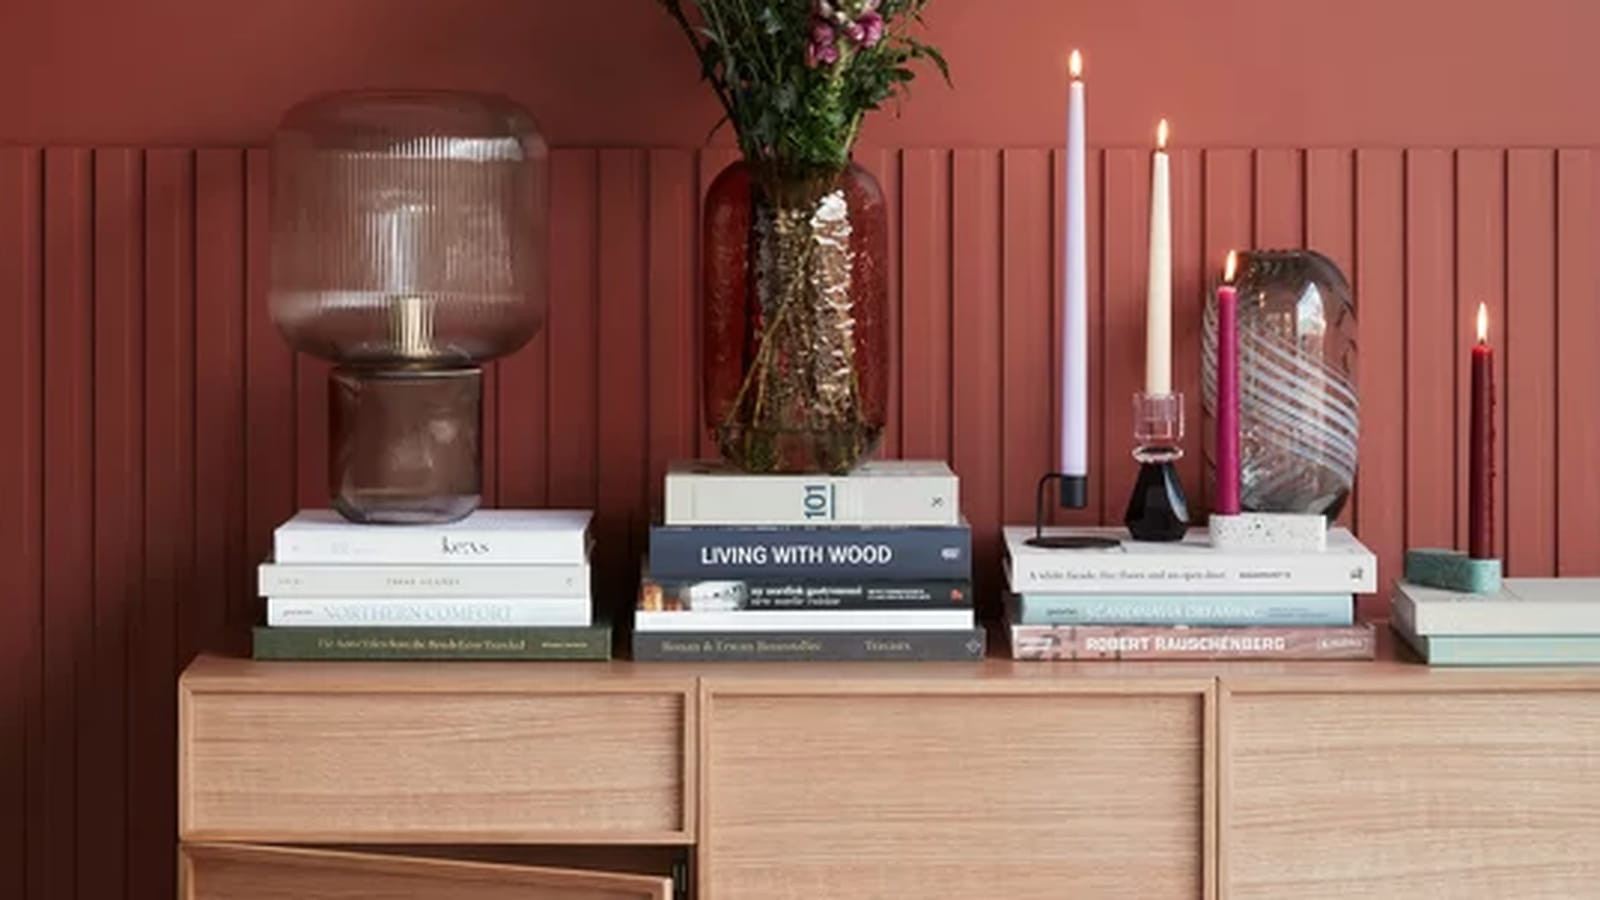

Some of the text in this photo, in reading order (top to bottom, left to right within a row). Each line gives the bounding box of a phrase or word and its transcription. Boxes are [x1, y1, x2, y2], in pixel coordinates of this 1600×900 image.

[805, 485, 827, 519] 101
[701, 545, 893, 564] LIVING WITH WOOD
[423, 605, 511, 621] COMFORT
[1085, 637, 1149, 651] ROBERT
